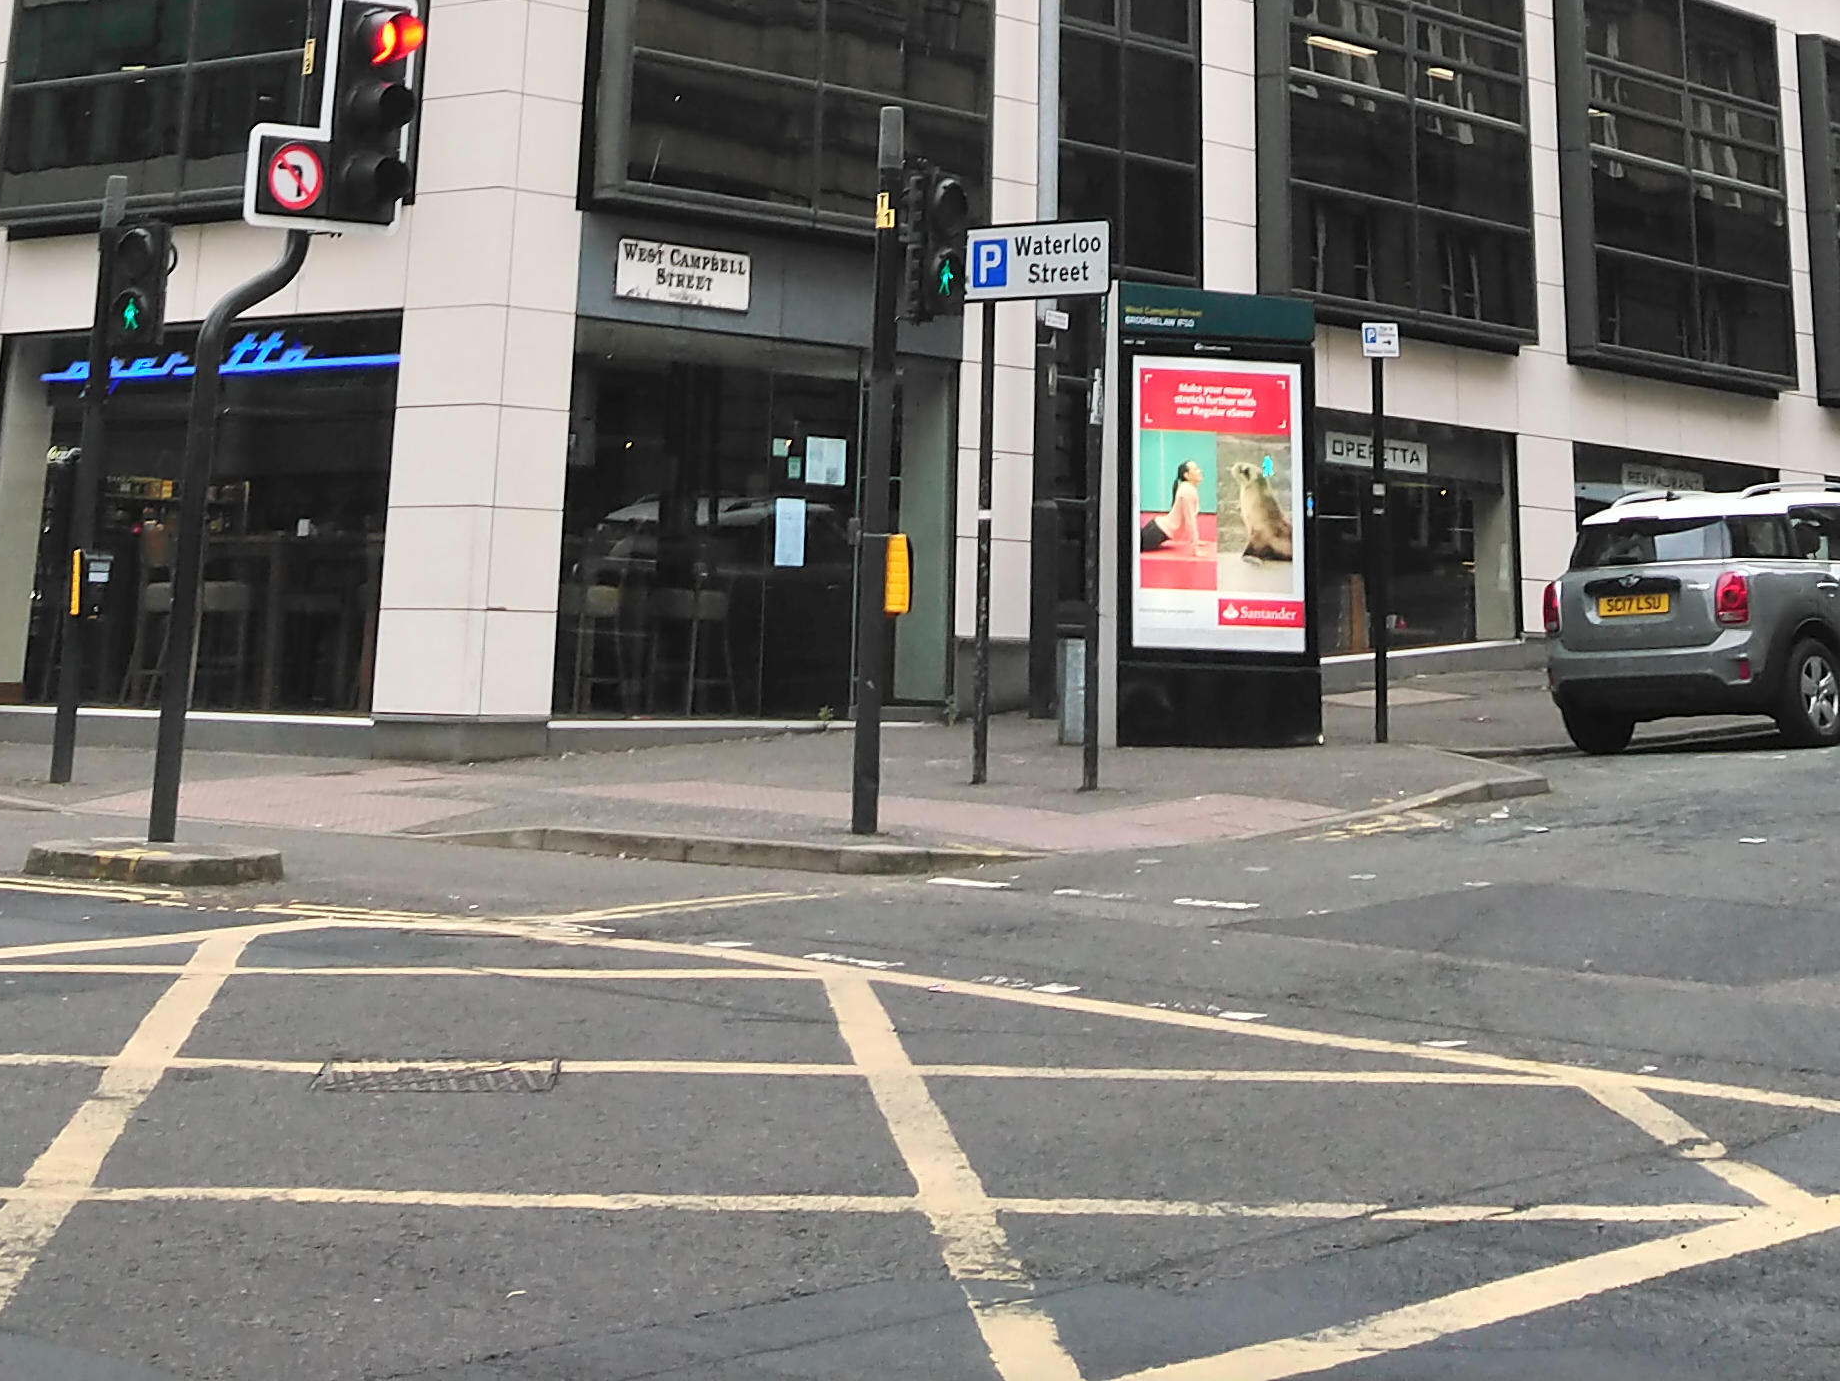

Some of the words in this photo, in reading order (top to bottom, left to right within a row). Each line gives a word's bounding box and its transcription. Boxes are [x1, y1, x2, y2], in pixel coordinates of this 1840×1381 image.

[1015, 233, 1101, 256] Waterloo
[624, 243, 664, 265] WEST
[670, 249, 747, 275] CAMPBELL
[980, 244, 1002, 284] P
[657, 268, 713, 291] STREET
[1028, 261, 1089, 283] Street
[1178, 383, 1202, 393] Make
[1203, 386, 1223, 396] your
[1223, 386, 1253, 398] money
[1174, 395, 1205, 405] stretch
[1205, 395, 1237, 405] further
[1237, 397, 1257, 407] with
[1176, 407, 1192, 416] our
[1192, 405, 1226, 419] Regular
[1636, 596, 1661, 611] LSU
[1240, 606, 1298, 621] Santander
